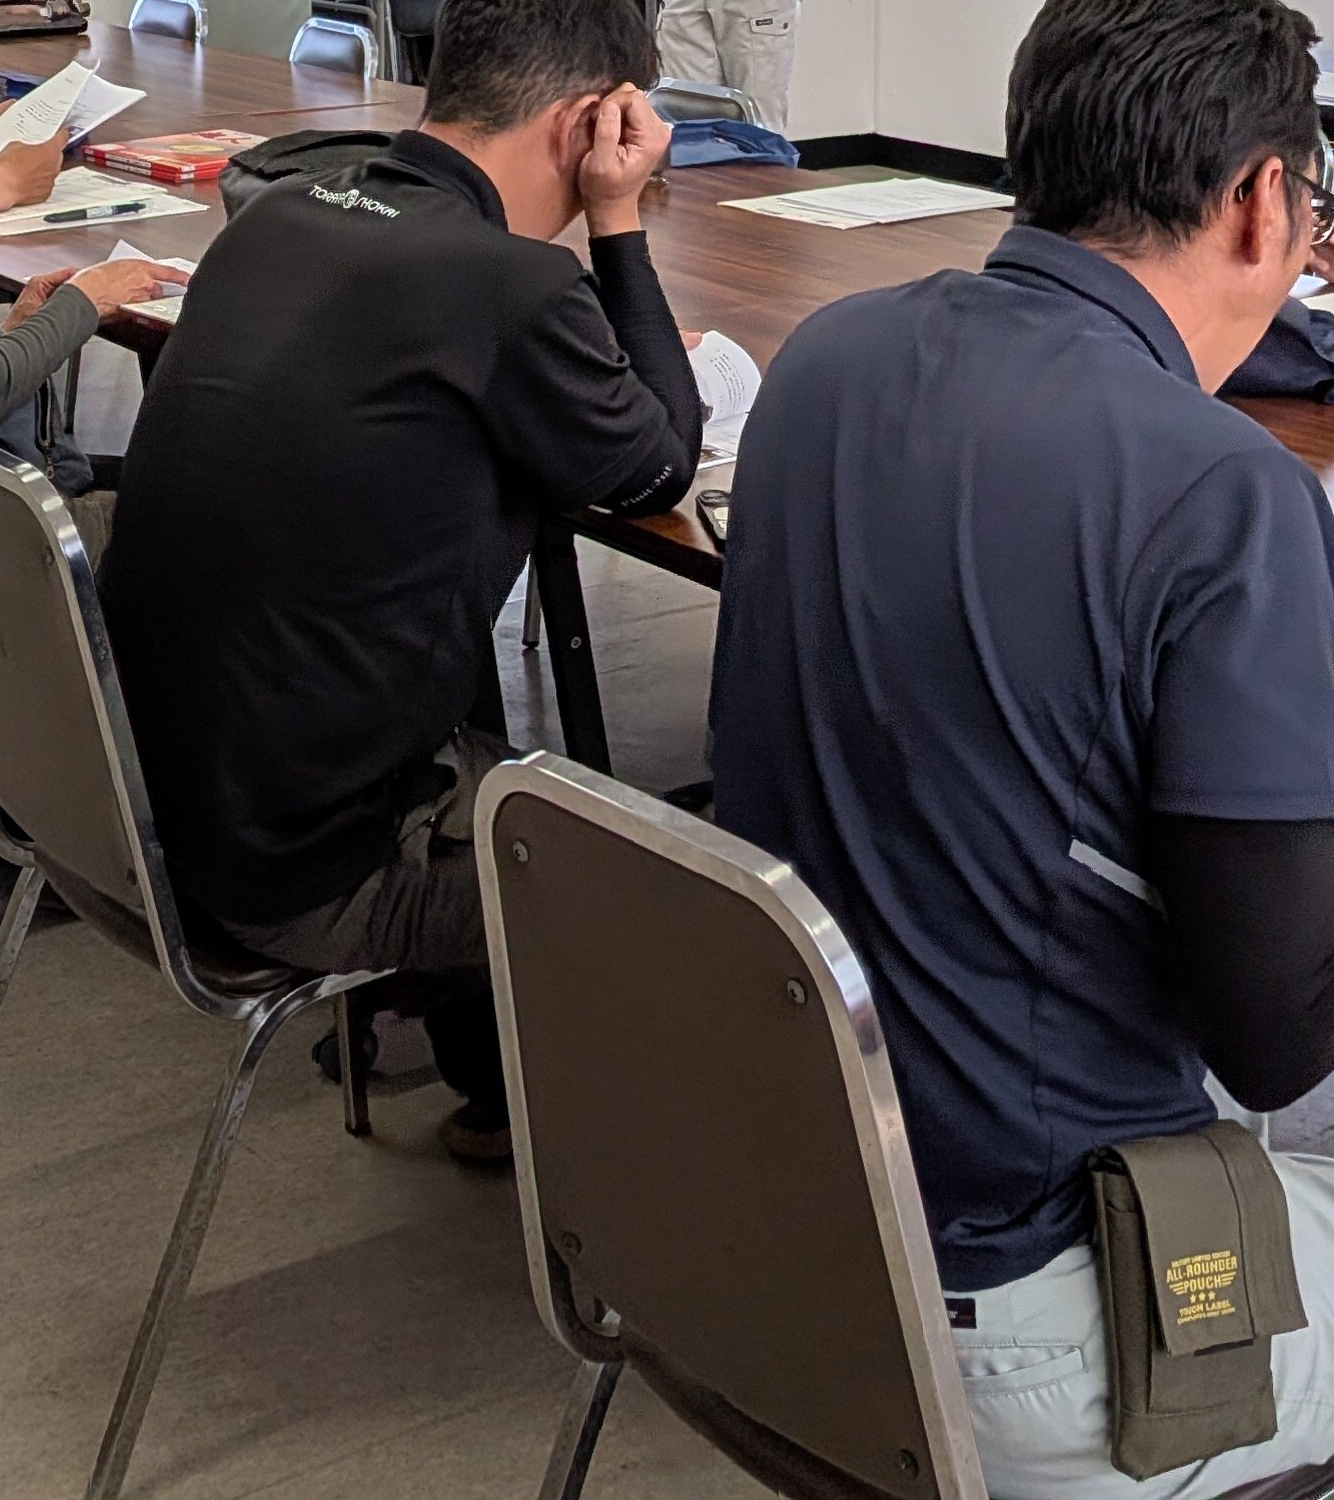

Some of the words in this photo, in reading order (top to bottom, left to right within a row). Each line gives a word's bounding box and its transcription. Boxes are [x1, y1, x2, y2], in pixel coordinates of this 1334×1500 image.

[354, 196, 401, 218] SHOKAI
[1166, 1256, 1238, 1283] ALL-ROUNDER
[1183, 1274, 1222, 1293] POUCH
